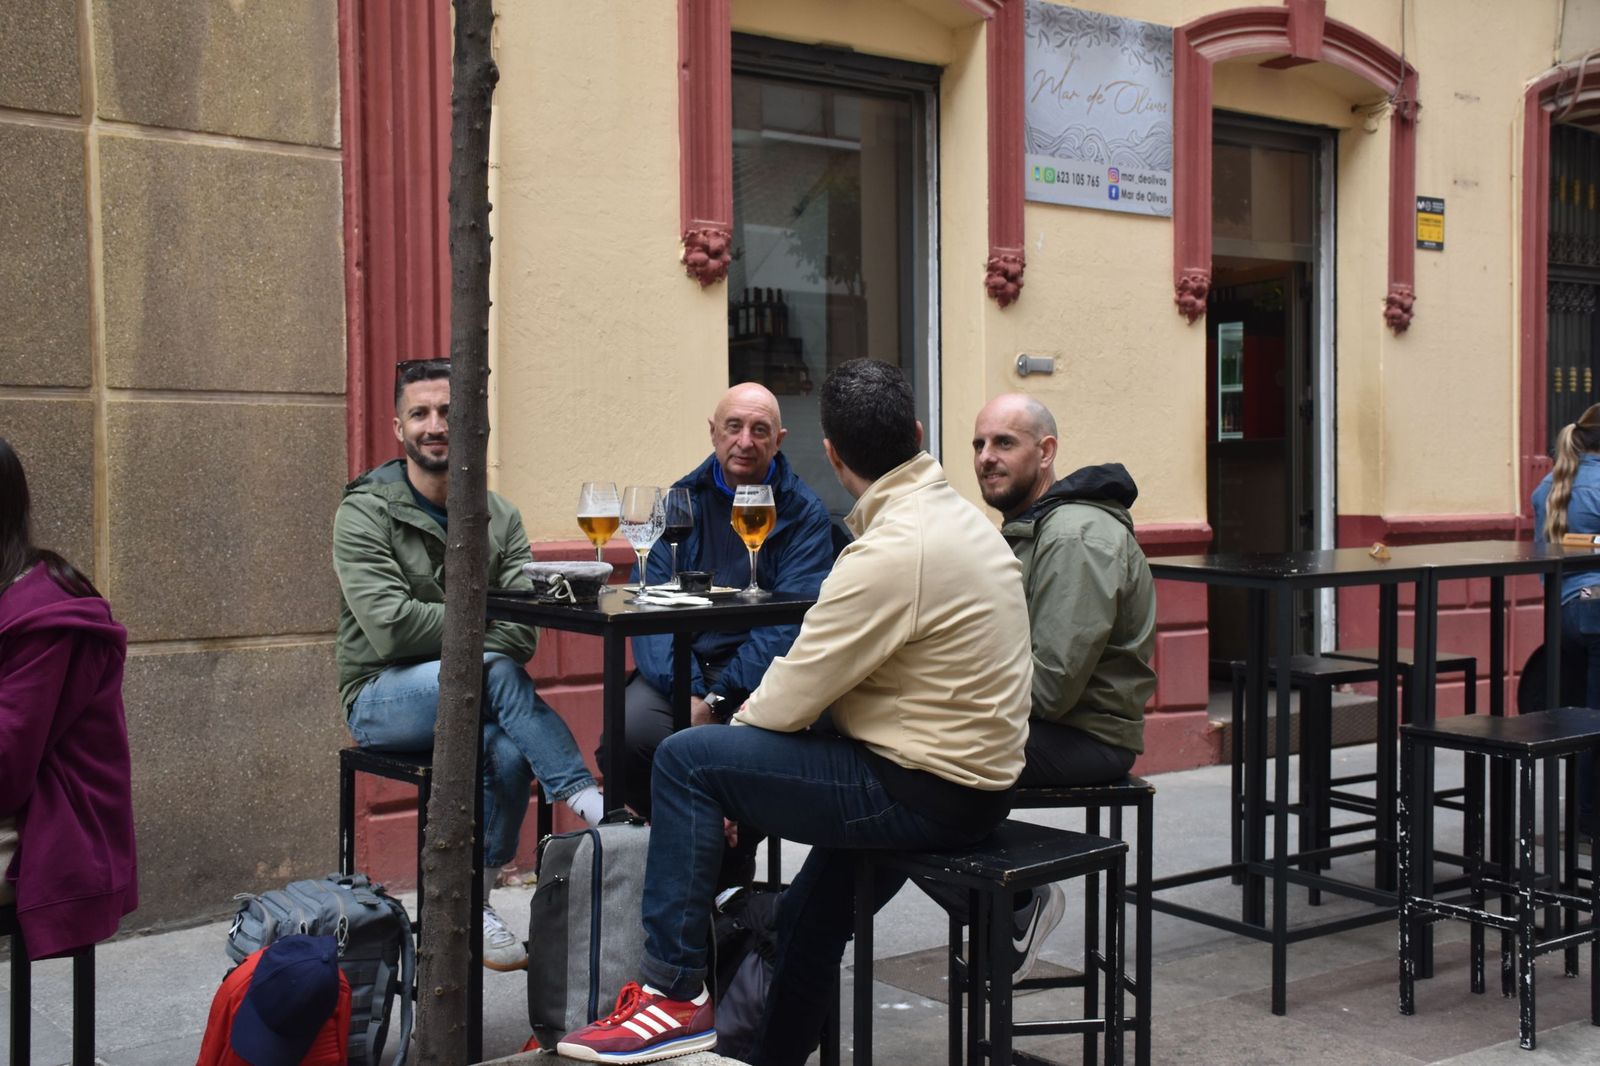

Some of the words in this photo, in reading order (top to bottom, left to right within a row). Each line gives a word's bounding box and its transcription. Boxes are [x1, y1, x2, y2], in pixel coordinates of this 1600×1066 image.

[1031, 57, 1079, 109] Mar
[1086, 84, 1106, 115] de
[1057, 171, 1070, 184] 623
[1072, 172, 1085, 186] 105
[1087, 174, 1100, 188] 765
[1121, 188, 1134, 199] Mar
[1136, 190, 1145, 201] de
